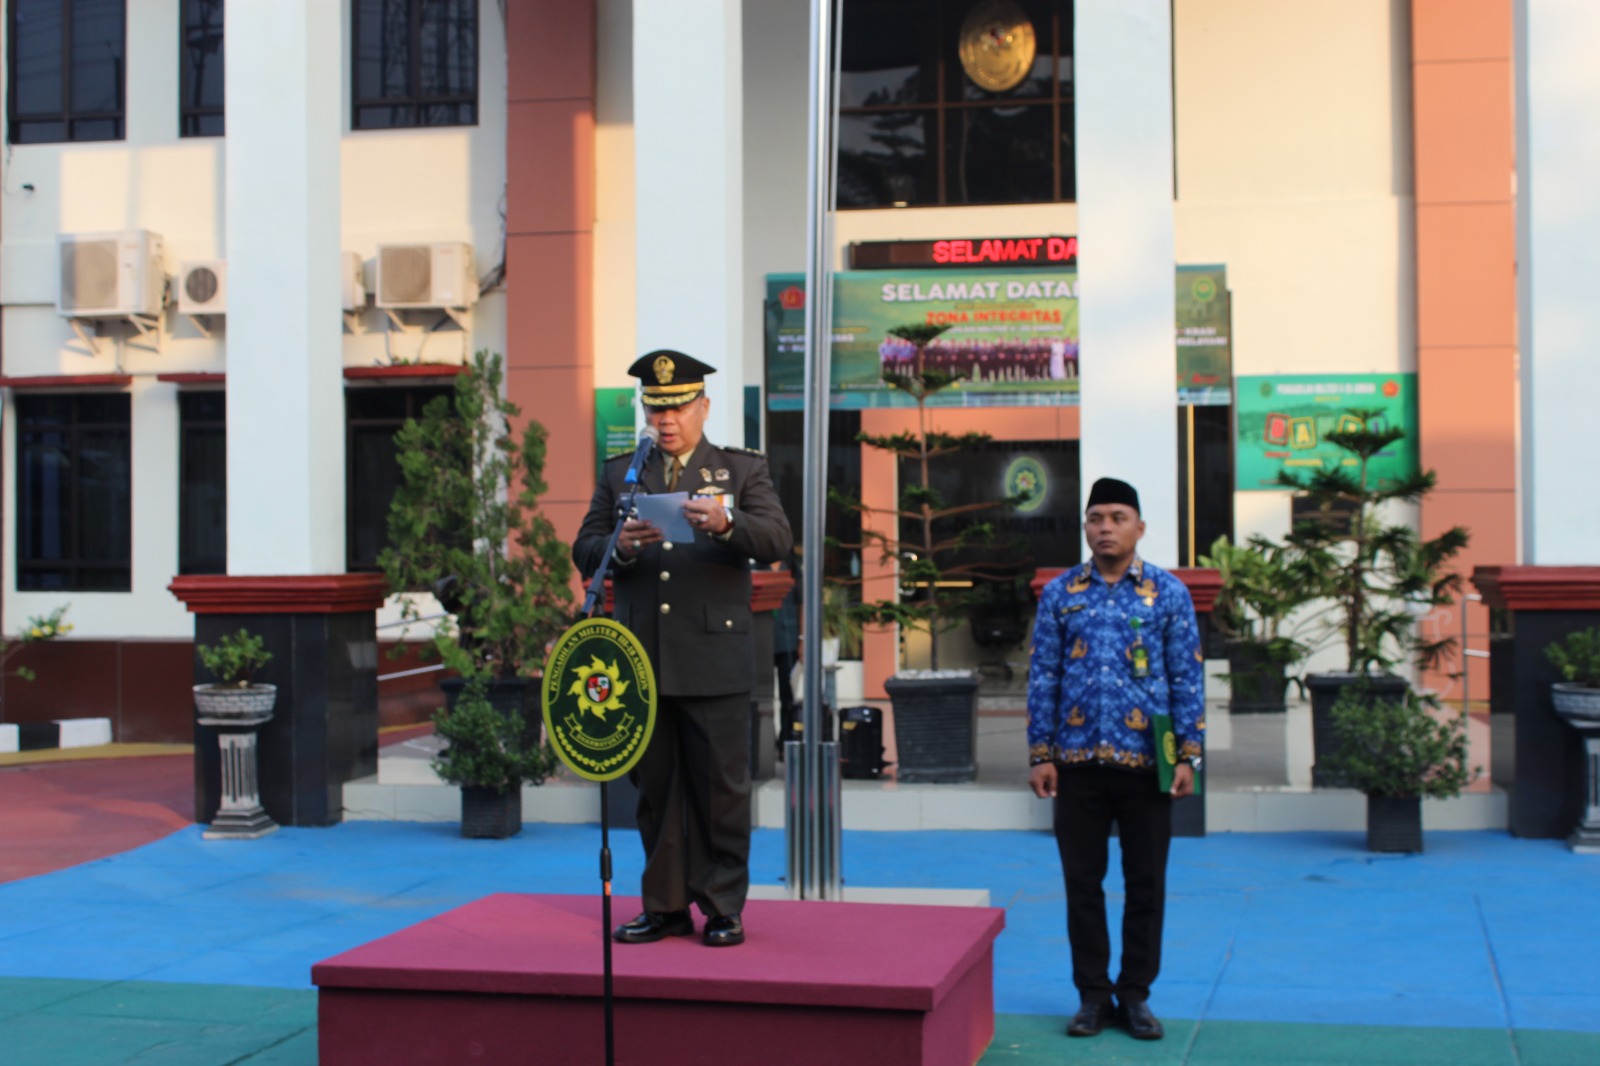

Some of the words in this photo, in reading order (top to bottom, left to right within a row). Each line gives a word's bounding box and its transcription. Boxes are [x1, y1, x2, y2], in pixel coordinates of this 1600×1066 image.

[932, 238, 1043, 264] SELAMAT
[881, 282, 1000, 301] SELAMAT
[926, 311, 969, 325] ZONA
[972, 309, 1062, 324] INTEGRITAS
[550, 635, 579, 691] PENGADILAN
[578, 626, 618, 639] MILITER
[632, 656, 648, 690] AMBON
